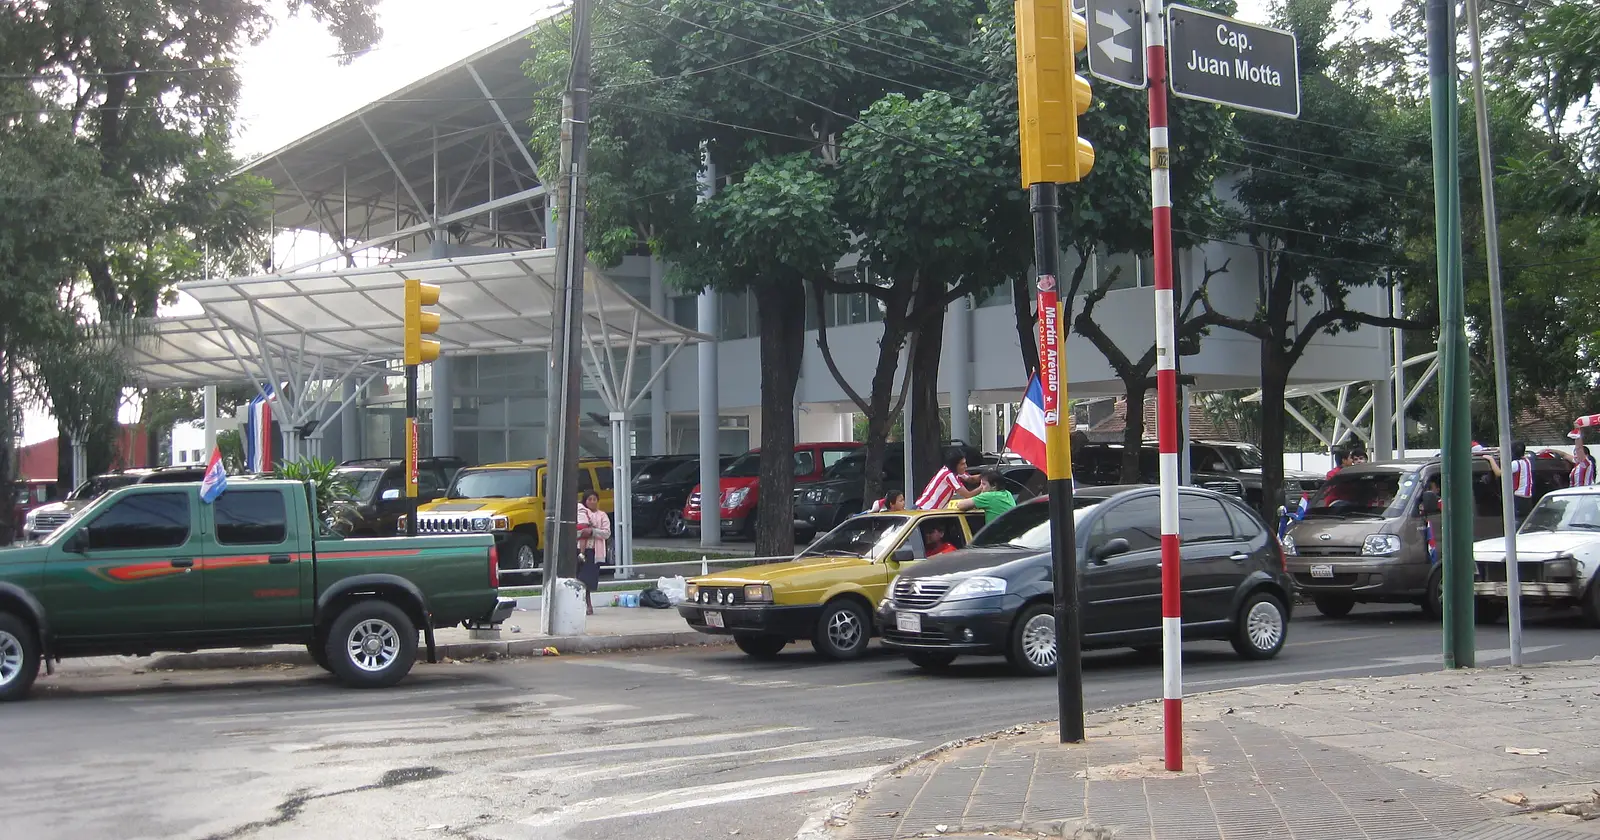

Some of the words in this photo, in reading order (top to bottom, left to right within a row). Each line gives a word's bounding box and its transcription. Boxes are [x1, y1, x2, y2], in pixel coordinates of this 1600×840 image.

[1216, 24, 1252, 53] Cap.
[1187, 49, 1230, 77] Juan
[1234, 58, 1281, 87] Motta
[1045, 306, 1058, 345] Martín
[1047, 348, 1058, 391] Arévalo
